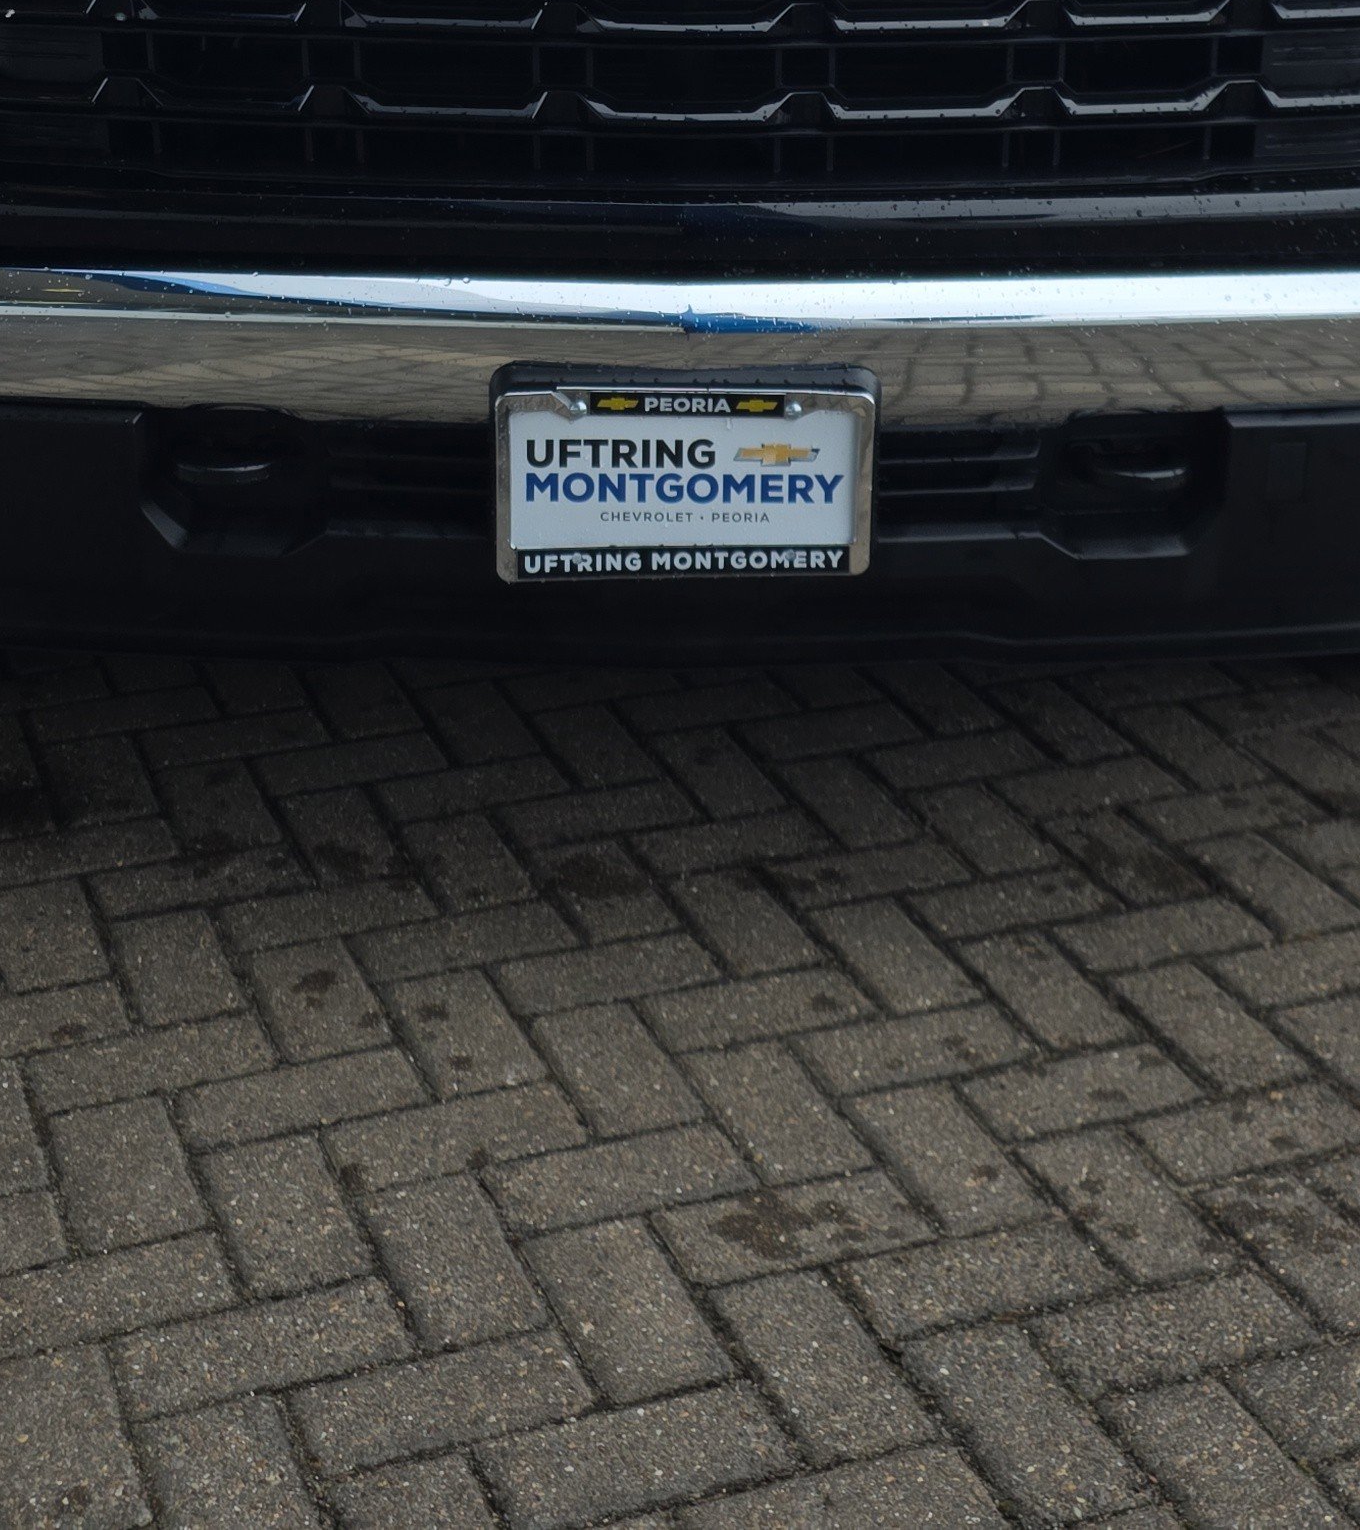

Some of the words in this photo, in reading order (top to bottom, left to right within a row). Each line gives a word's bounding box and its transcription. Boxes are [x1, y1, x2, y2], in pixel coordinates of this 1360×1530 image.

[644, 397, 731, 413] PEORIA
[526, 438, 716, 469] UFTRING
[525, 472, 844, 505] MONTGOMERY
[600, 511, 693, 523] CHEVROLET
[711, 511, 770, 523] PEORIA
[524, 551, 642, 574] UFTRING
[651, 549, 844, 571] MONTGOMERY
